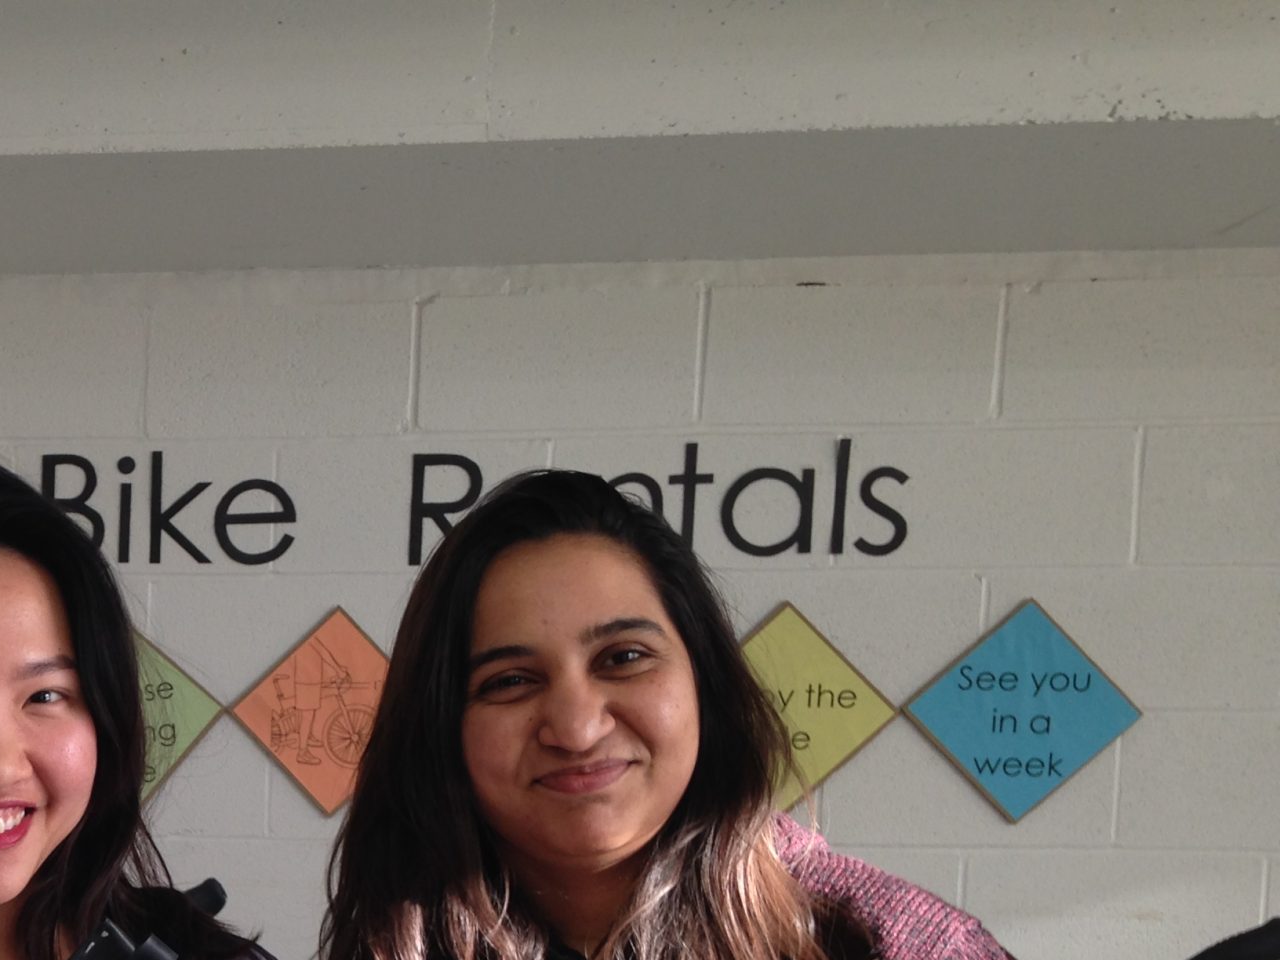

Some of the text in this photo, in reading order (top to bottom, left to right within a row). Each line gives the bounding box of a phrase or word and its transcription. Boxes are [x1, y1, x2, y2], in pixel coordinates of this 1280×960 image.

[41, 450, 297, 566] Bike
[143, 681, 175, 702] se
[957, 665, 1092, 698] See you
[805, 682, 858, 710] the
[991, 707, 1052, 736] in a
[973, 751, 1064, 778] week
